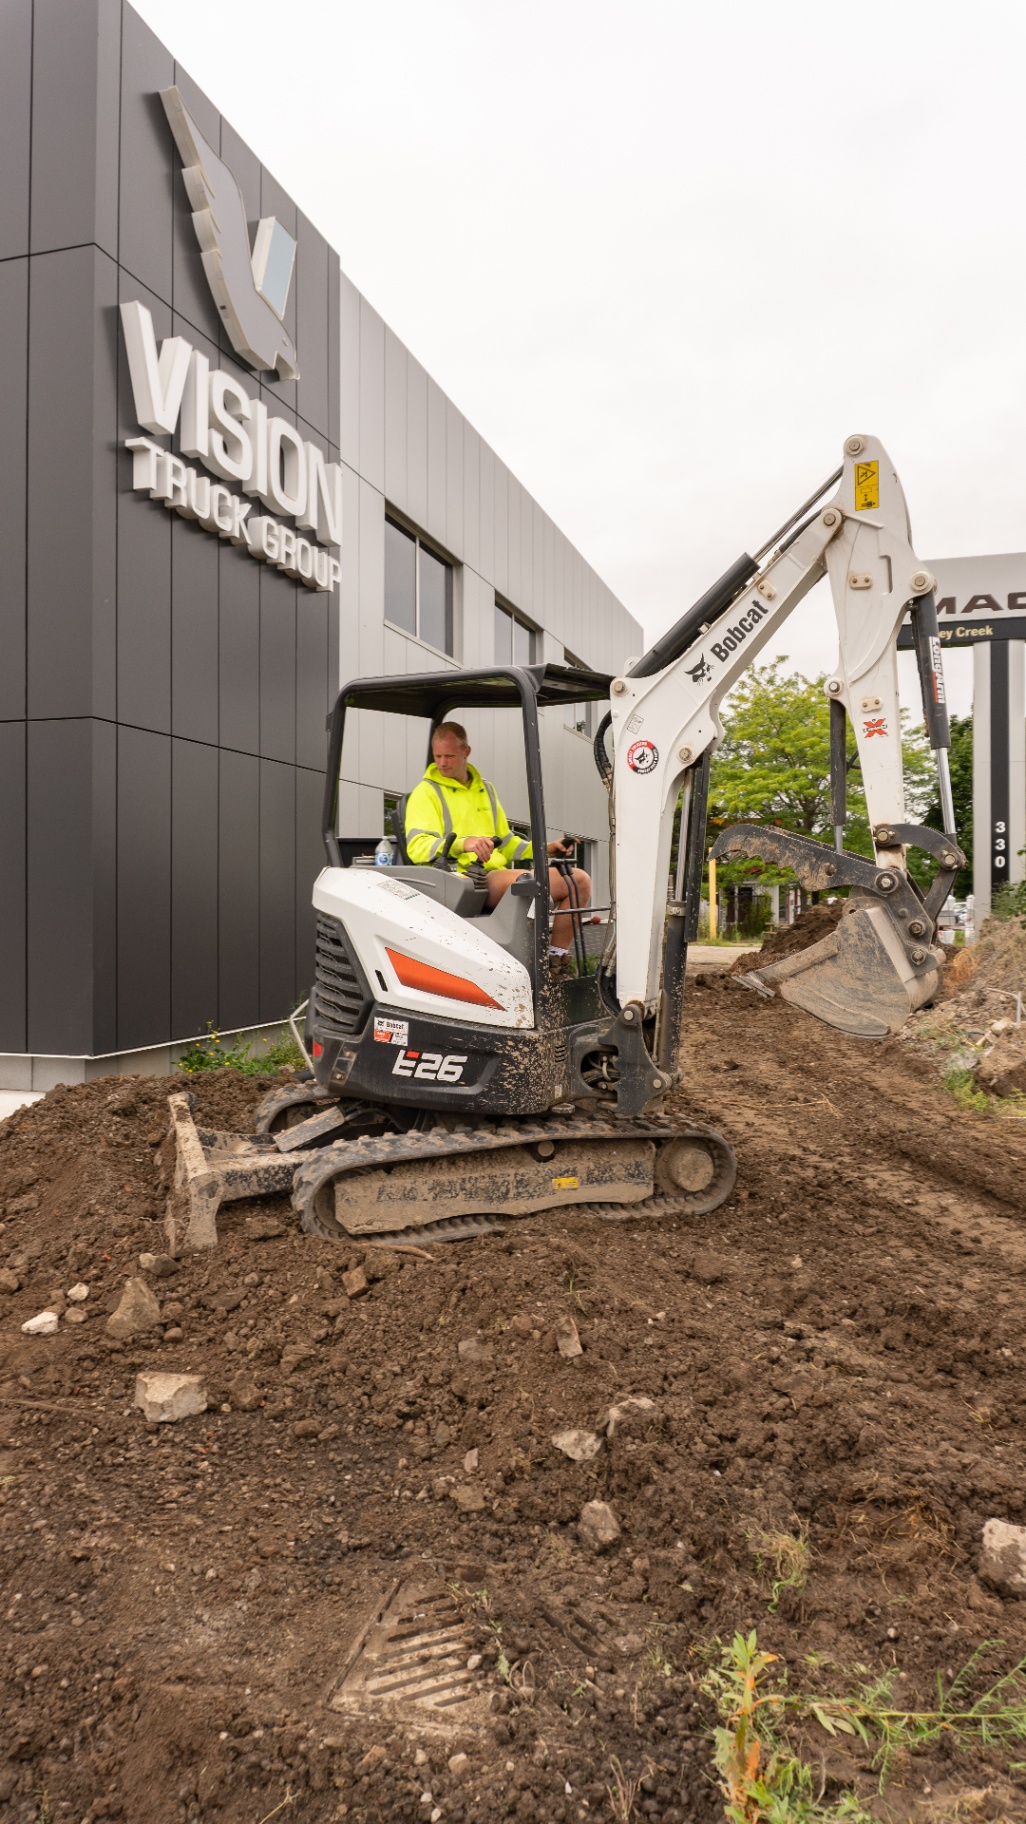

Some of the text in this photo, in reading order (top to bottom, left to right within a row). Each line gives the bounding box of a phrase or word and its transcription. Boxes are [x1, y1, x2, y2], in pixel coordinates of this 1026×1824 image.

[120, 300, 342, 547] VISION
[125, 436, 342, 592] TRUCK GROUP
[710, 599, 769, 663] Bobcat
[955, 625, 993, 637] Creek
[392, 1050, 468, 1082] E26
